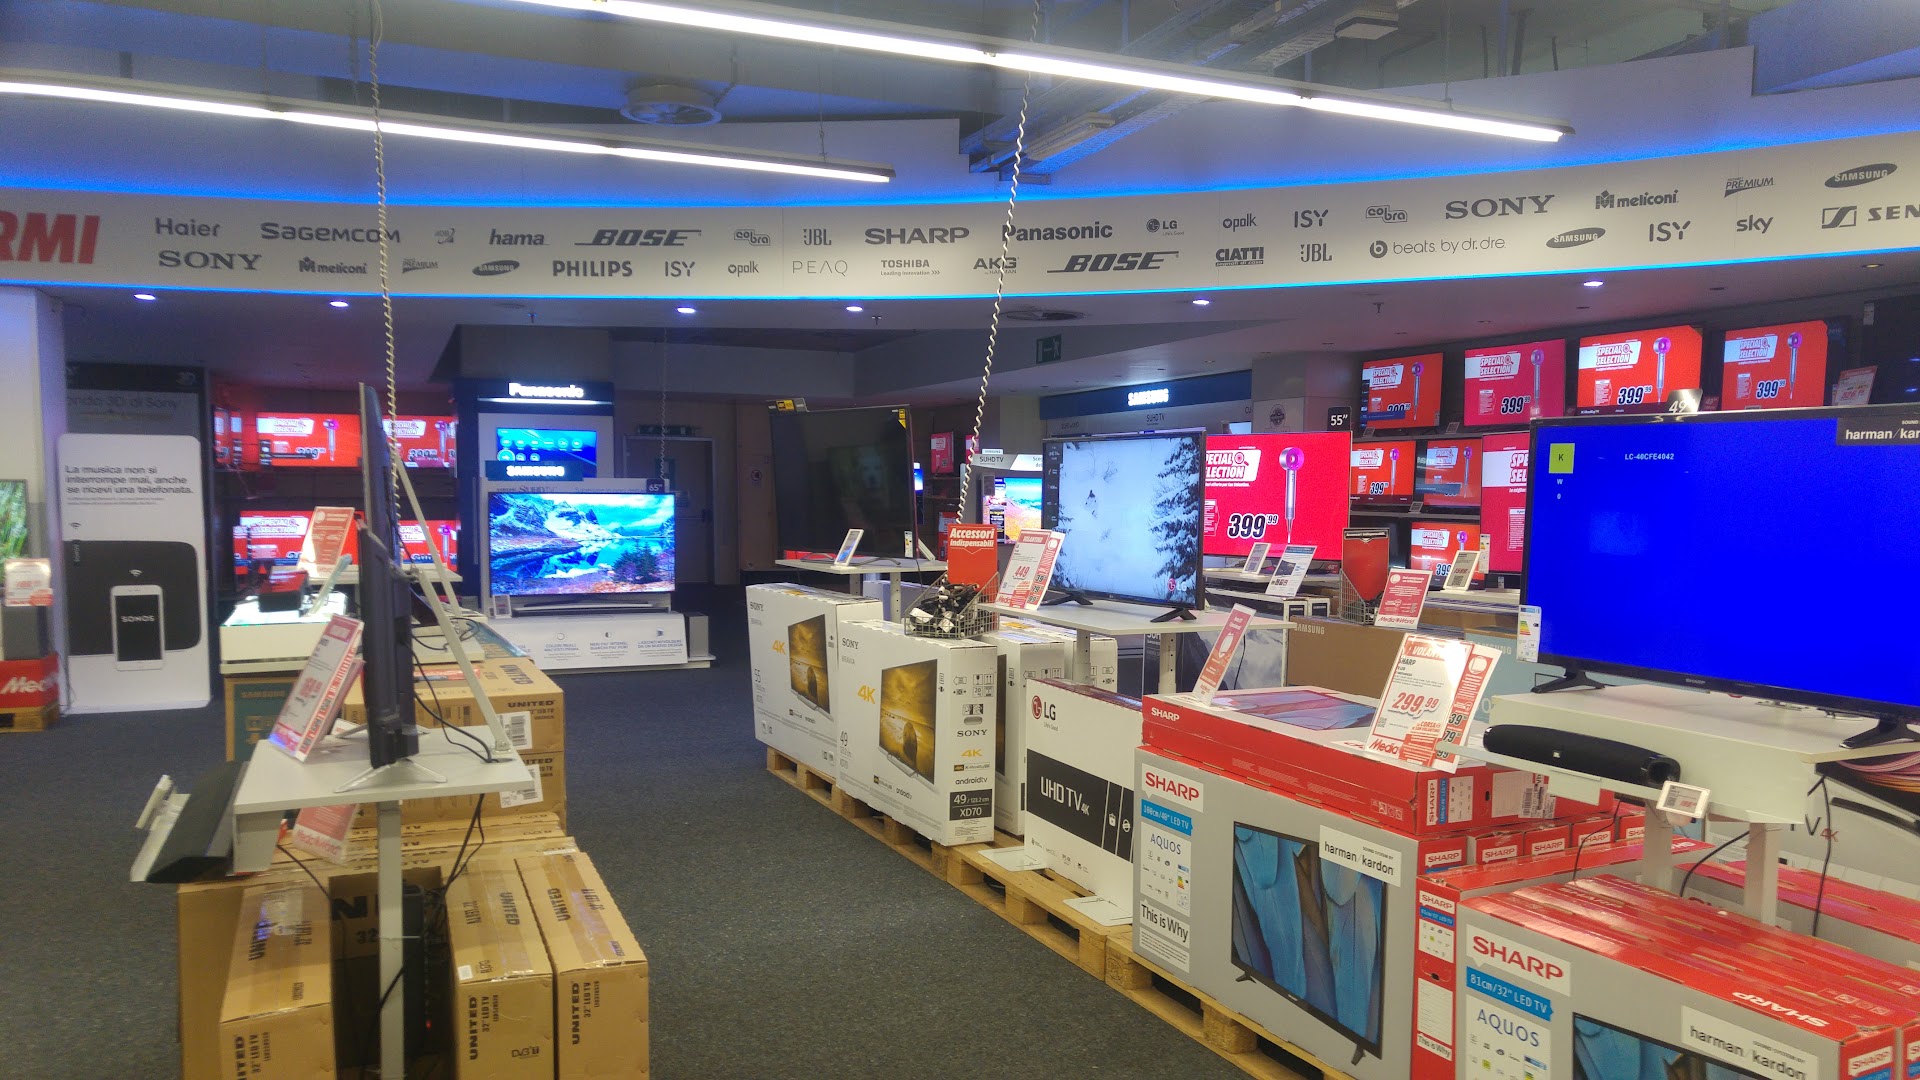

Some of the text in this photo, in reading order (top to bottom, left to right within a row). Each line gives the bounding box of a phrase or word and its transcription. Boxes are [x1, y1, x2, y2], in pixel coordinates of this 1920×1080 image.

[1726, 177, 1774, 190] PREMIUM
[1833, 168, 1889, 183] SAMSUNG
[1445, 195, 1555, 219] SONY
[1616, 189, 1679, 208] meliconi
[1162, 220, 1178, 230] LG
[1232, 213, 1257, 232] polk
[1294, 209, 1329, 228] ISY
[1736, 214, 1774, 234] sky
[155, 217, 220, 238] Haier
[864, 227, 970, 245] SHARP
[1002, 221, 1113, 242] Panasonic
[1649, 220, 1691, 242] ISY
[489, 229, 545, 246] hama
[574, 229, 701, 246] BOSE
[803, 228, 832, 246] JBL
[1553, 232, 1599, 243] SAMSUNG
[1216, 247, 1264, 261] CIATTI
[1301, 243, 1333, 262] JBL
[1440, 239, 1460, 254] by
[158, 250, 262, 271] SONY
[317, 262, 368, 274] meliconi
[552, 260, 633, 277] PHILIPS
[665, 260, 696, 277] ISY
[737, 261, 760, 277] polk
[881, 259, 930, 268] TOSHIBA
[973, 258, 1017, 270] AKG
[1047, 251, 1179, 273] BOSE
[1596, 345, 1622, 357] SPECIAL
[1596, 353, 1630, 366] SELECTION
[508, 382, 585, 399] Panasonic
[1618, 386, 1644, 406] 399
[1756, 379, 1779, 400] 399
[1501, 396, 1525, 414] 399
[949, 528, 995, 539] Accessori
[1228, 513, 1266, 539] 399
[950, 539, 995, 548] indispensabili
[1014, 565, 1030, 579] 449
[750, 601, 764, 612] SONY
[120, 615, 155, 623] SONOS
[1294, 623, 1325, 635] SAMSUNG
[772, 640, 786, 656] 4K
[841, 638, 859, 650] SONY
[499, 664, 534, 685] UNITED
[857, 685, 877, 705] 4K
[507, 700, 555, 709] UNITED
[1044, 701, 1056, 721] LG
[1151, 707, 1180, 722] SHARP
[840, 731, 849, 747] 49
[957, 729, 988, 738] SONY
[961, 749, 983, 758] 4K
[1145, 772, 1200, 801] SHARP
[953, 794, 967, 805] 49
[1041, 776, 1090, 816] UHD TV 4K
[959, 806, 982, 817] XD70
[1171, 815, 1182, 827] LED
[1182, 820, 1190, 830] TV
[1150, 833, 1182, 855] AQUOS
[1534, 840, 1564, 852] SHARP
[1581, 834, 1609, 844] SHARP
[1324, 841, 1394, 876] harman kardon
[1428, 852, 1459, 863] SHARP
[1485, 847, 1517, 859] SHARP
[499, 891, 521, 926] UNITED
[547, 887, 572, 922] UNITED
[1421, 894, 1453, 909] SHARP
[1141, 904, 1189, 944] This is Why
[1472, 936, 1564, 980] SHARP
[1514, 992, 1533, 1007] LED
[1533, 1000, 1548, 1014] TV
[1731, 991, 1830, 1028] SHARP
[571, 982, 581, 1045] UNITED
[468, 996, 479, 1060] UNITED
[1477, 1009, 1540, 1047] AQUOS
[1690, 1026, 1807, 1080] harman kardon
[1852, 1050, 1890, 1070] SHARP
